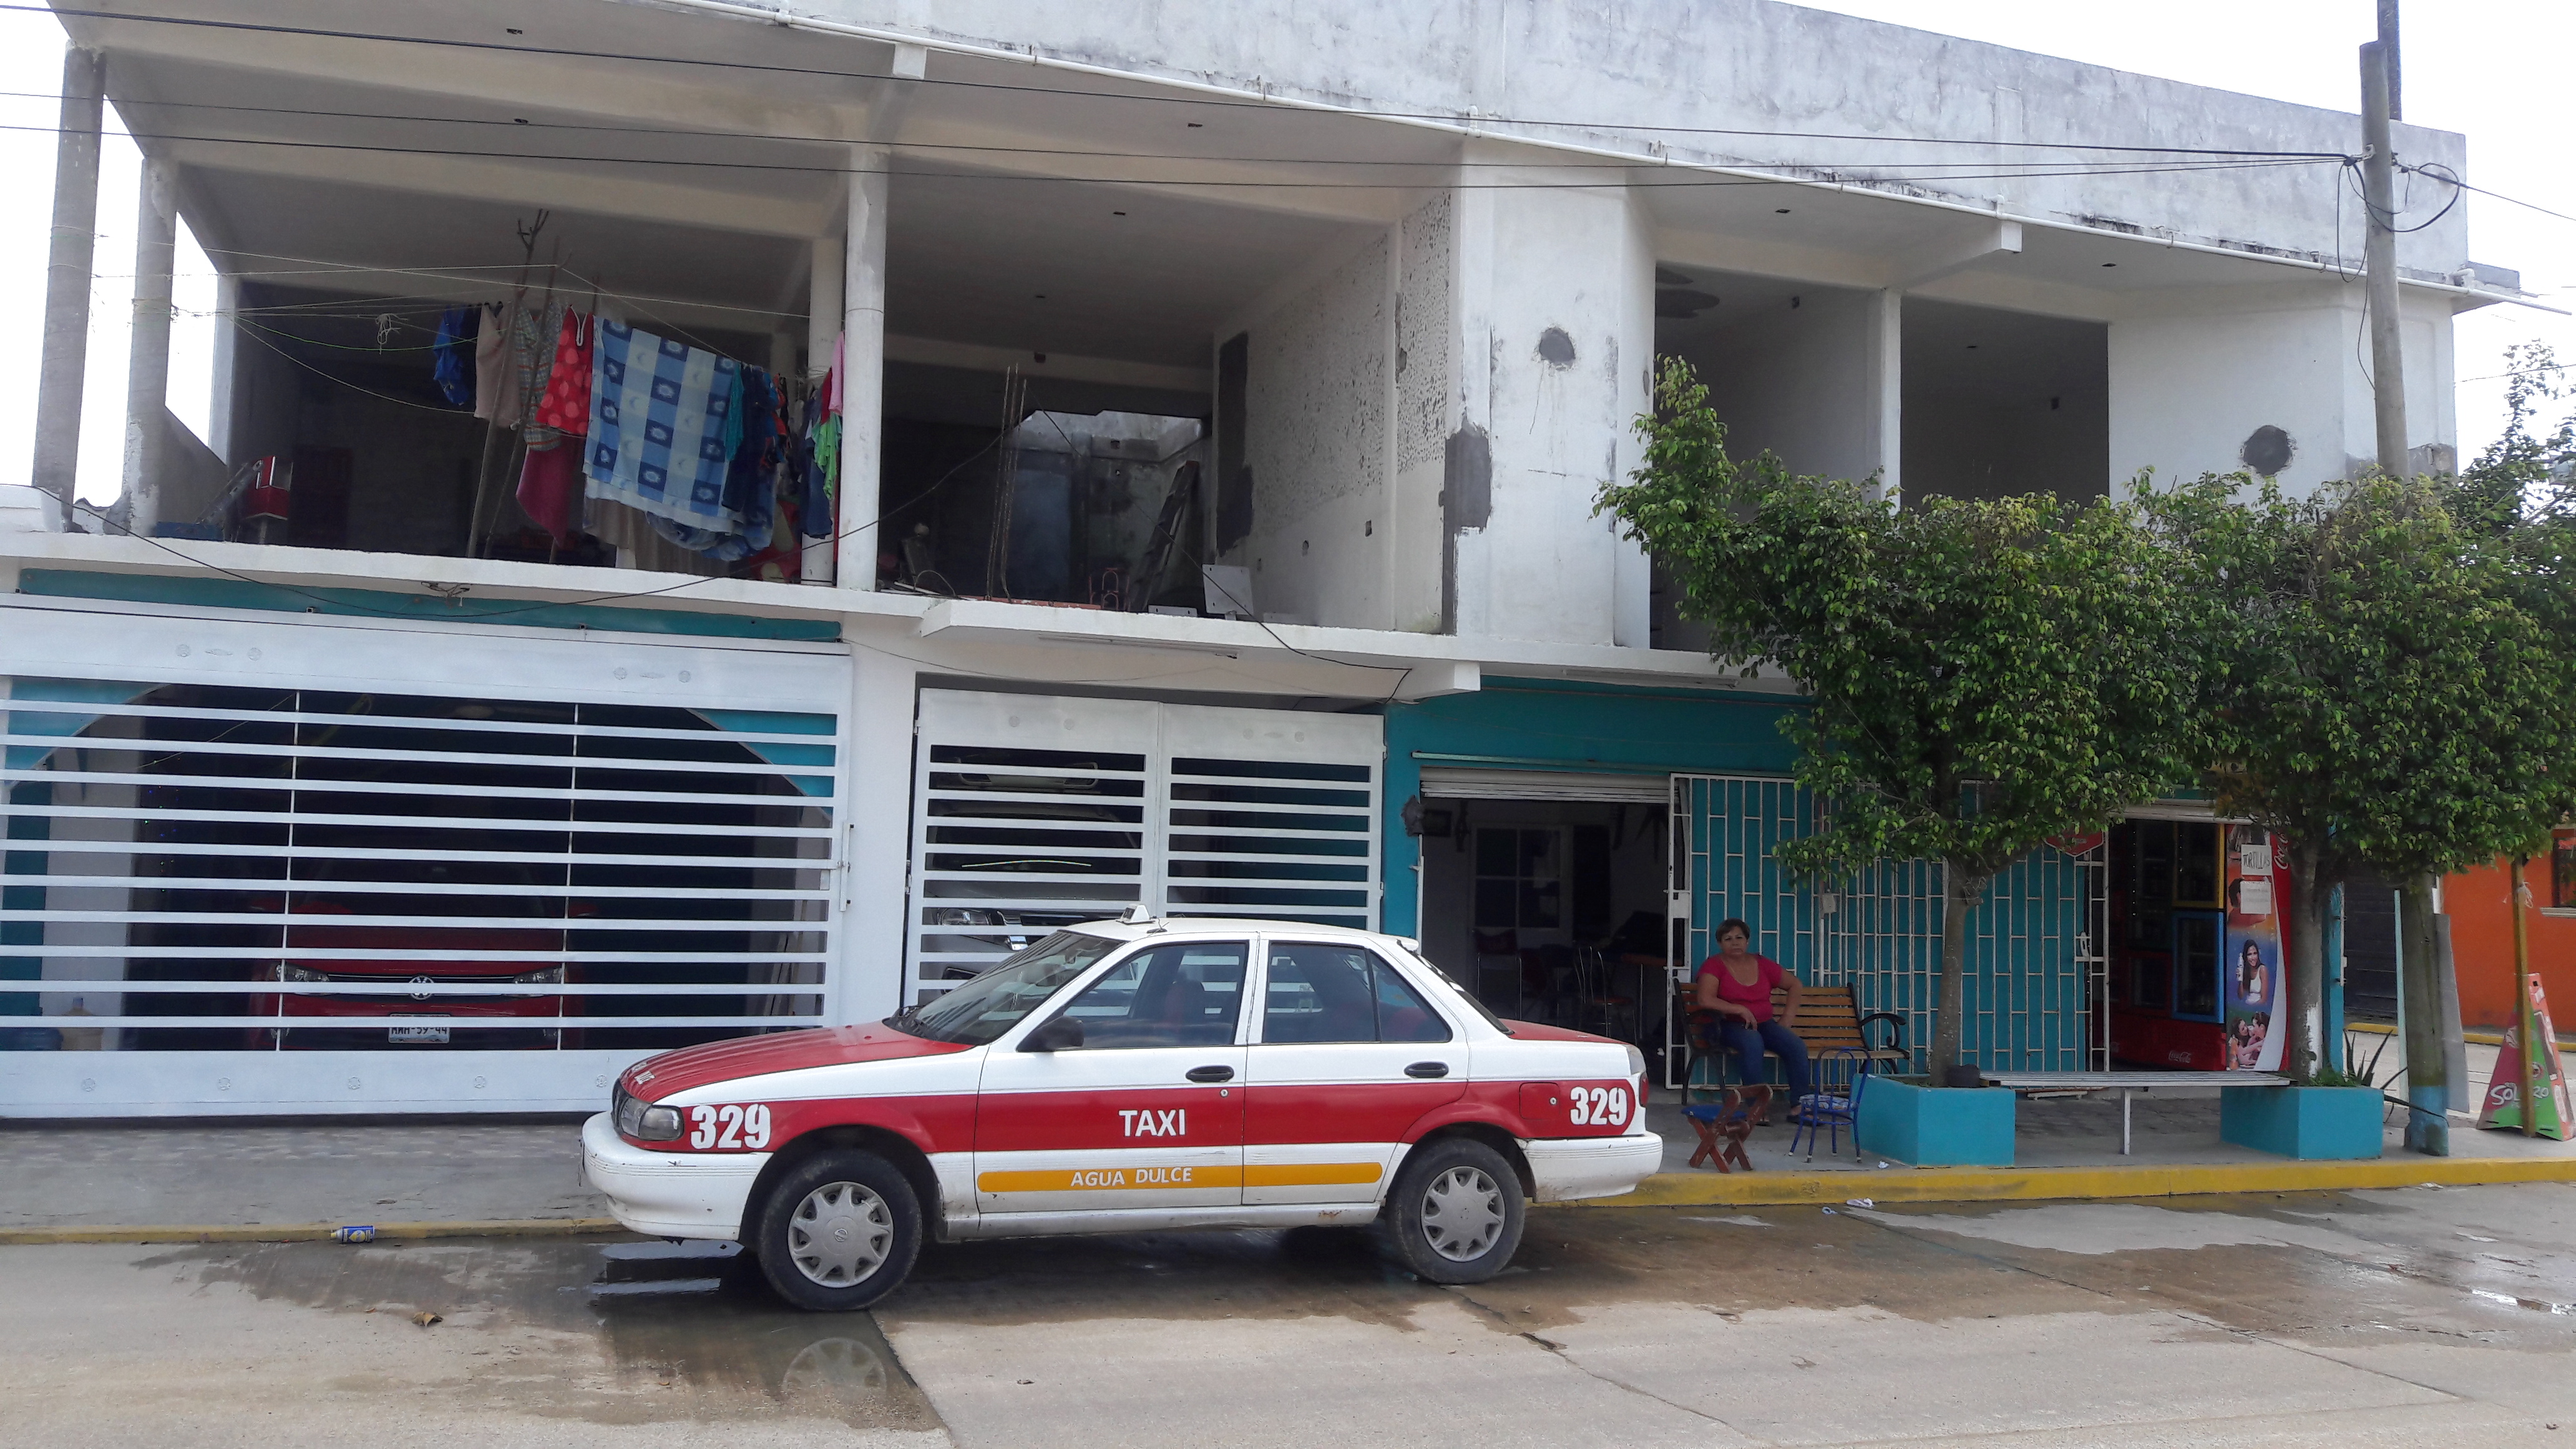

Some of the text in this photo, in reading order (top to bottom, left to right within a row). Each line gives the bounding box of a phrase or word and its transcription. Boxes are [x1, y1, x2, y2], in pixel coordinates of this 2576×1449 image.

[1118, 1108, 1186, 1137] TAXI
[1570, 1086, 1627, 1126] 329
[691, 1103, 771, 1149] 329
[1070, 1167, 1193, 1186] AGUA DULCE
